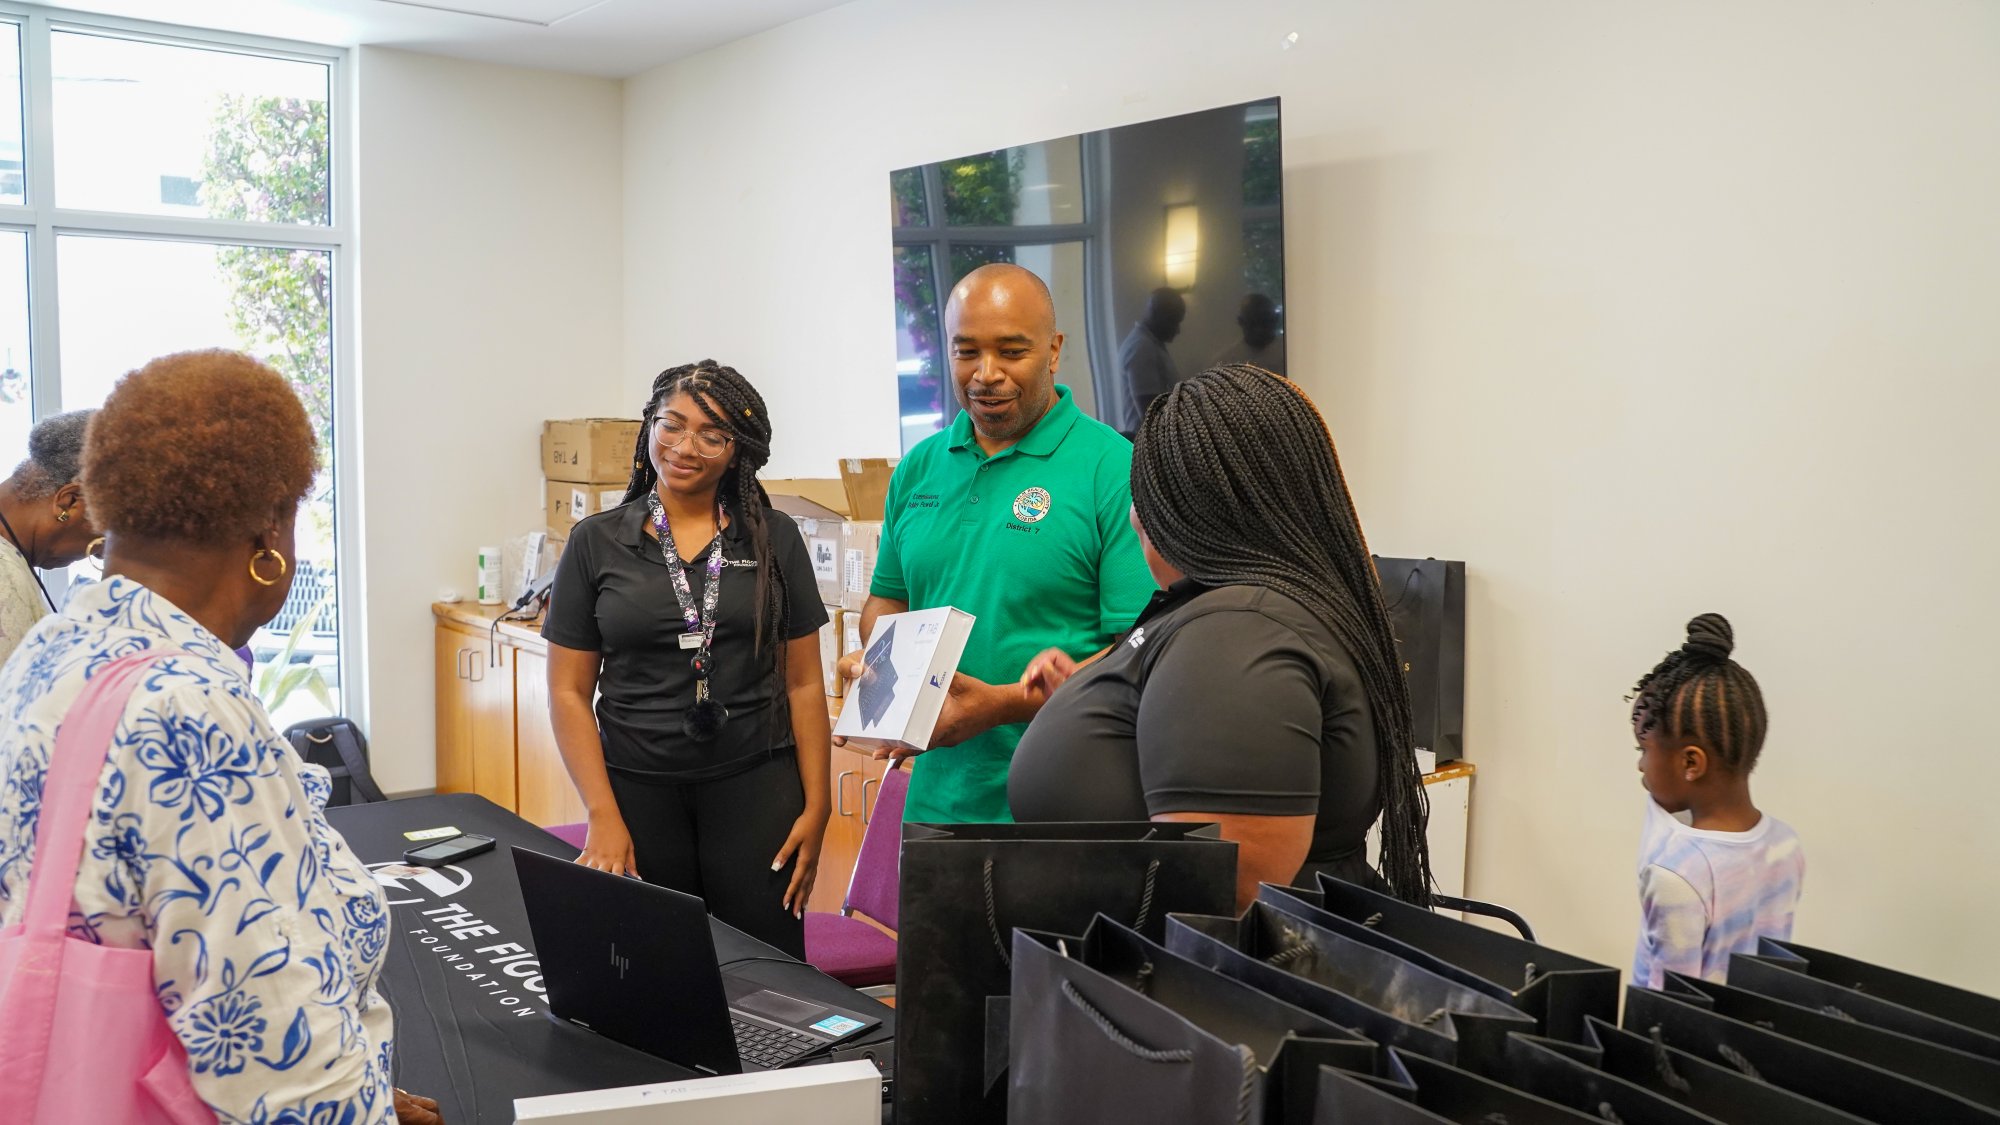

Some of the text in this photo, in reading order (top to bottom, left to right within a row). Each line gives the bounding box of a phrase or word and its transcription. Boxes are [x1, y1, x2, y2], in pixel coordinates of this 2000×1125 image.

[1006, 522, 1040, 535] District 7
[421, 902, 500, 941] THE
[409, 928, 536, 1018] FOUNDATION
